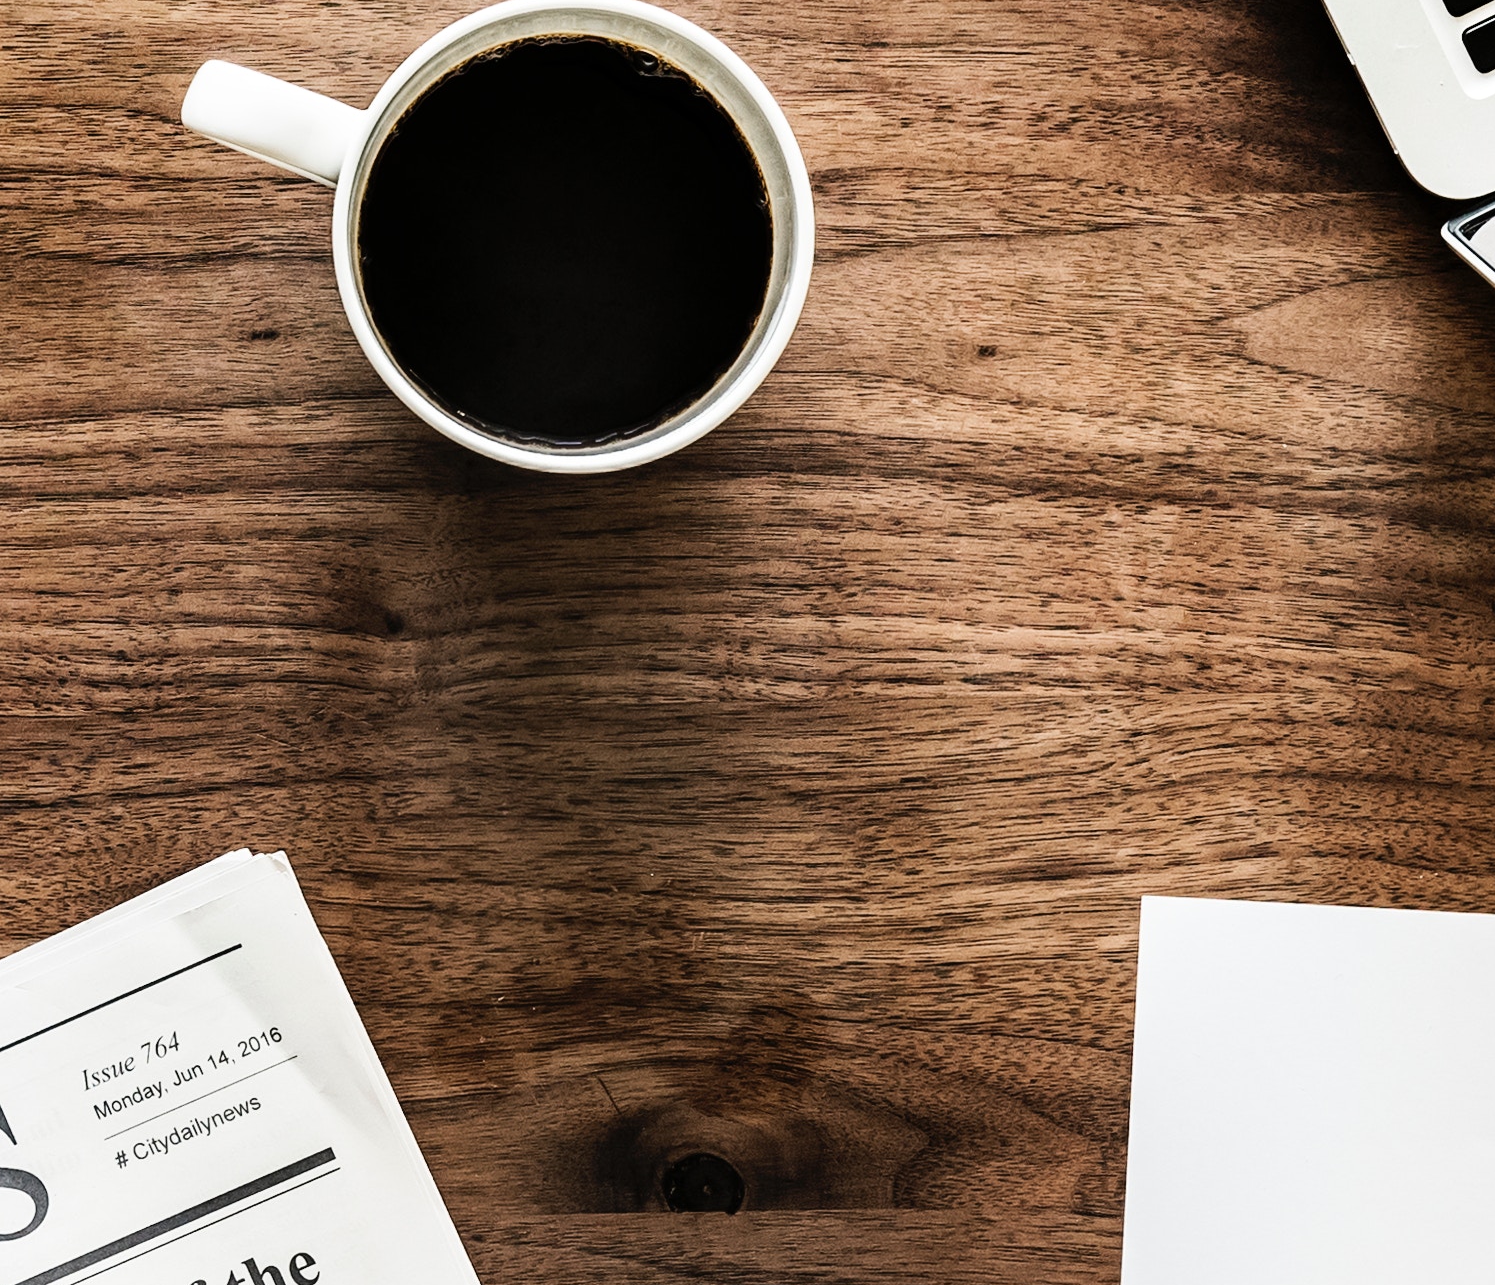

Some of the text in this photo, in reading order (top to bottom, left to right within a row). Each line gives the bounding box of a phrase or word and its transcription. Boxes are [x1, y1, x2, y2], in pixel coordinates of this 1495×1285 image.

[82, 1031, 180, 1091] Issue 764
[93, 1026, 282, 1120] Monday, Jun 14, 2016
[114, 1096, 263, 1169] # Citydailynews
